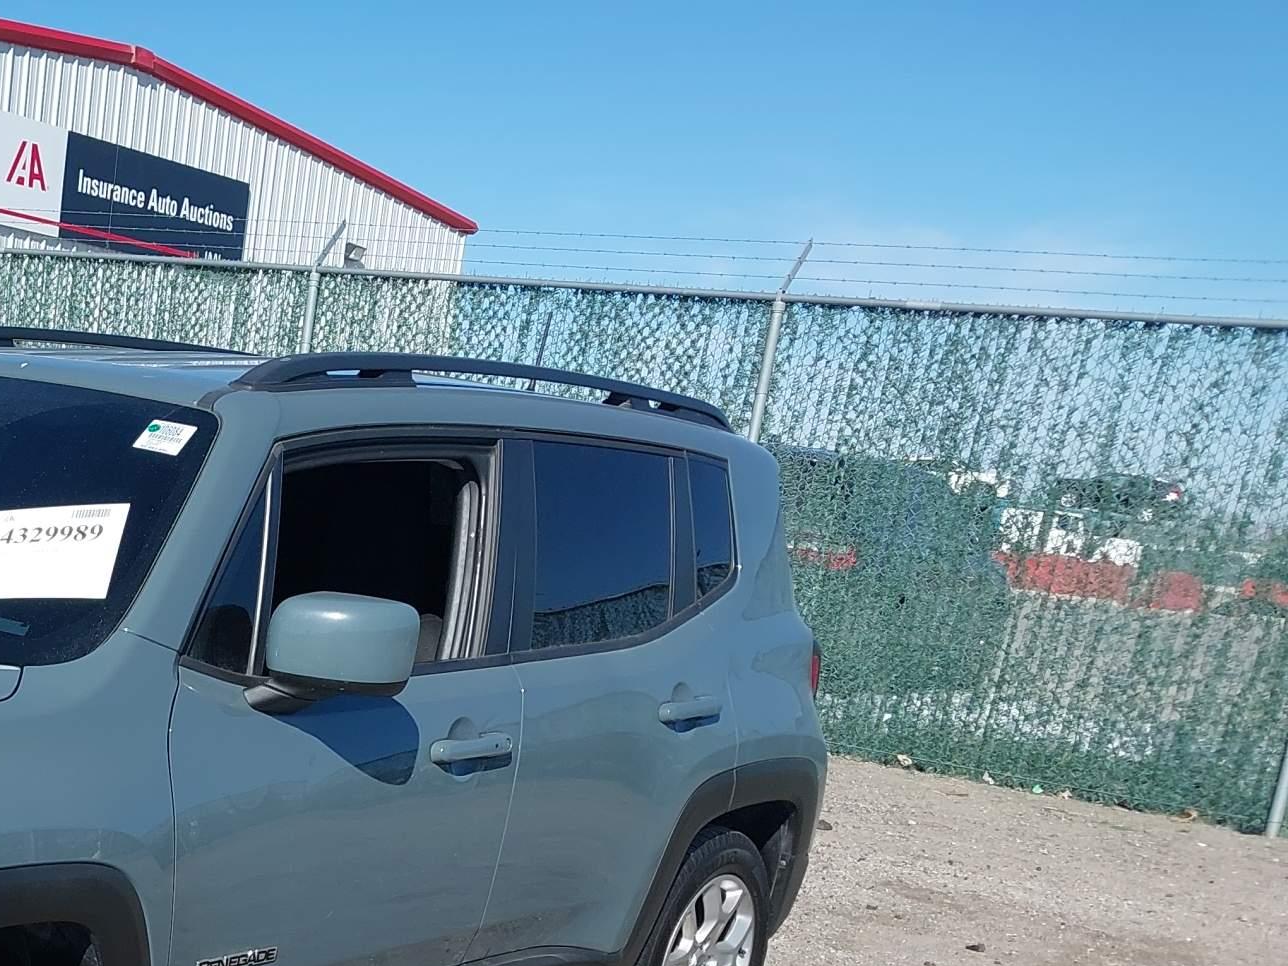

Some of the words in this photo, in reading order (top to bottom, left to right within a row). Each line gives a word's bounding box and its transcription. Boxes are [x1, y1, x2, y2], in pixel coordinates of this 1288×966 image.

[77, 168, 145, 208] Insurance
[147, 188, 178, 217] Auto
[180, 197, 234, 231] Auctions
